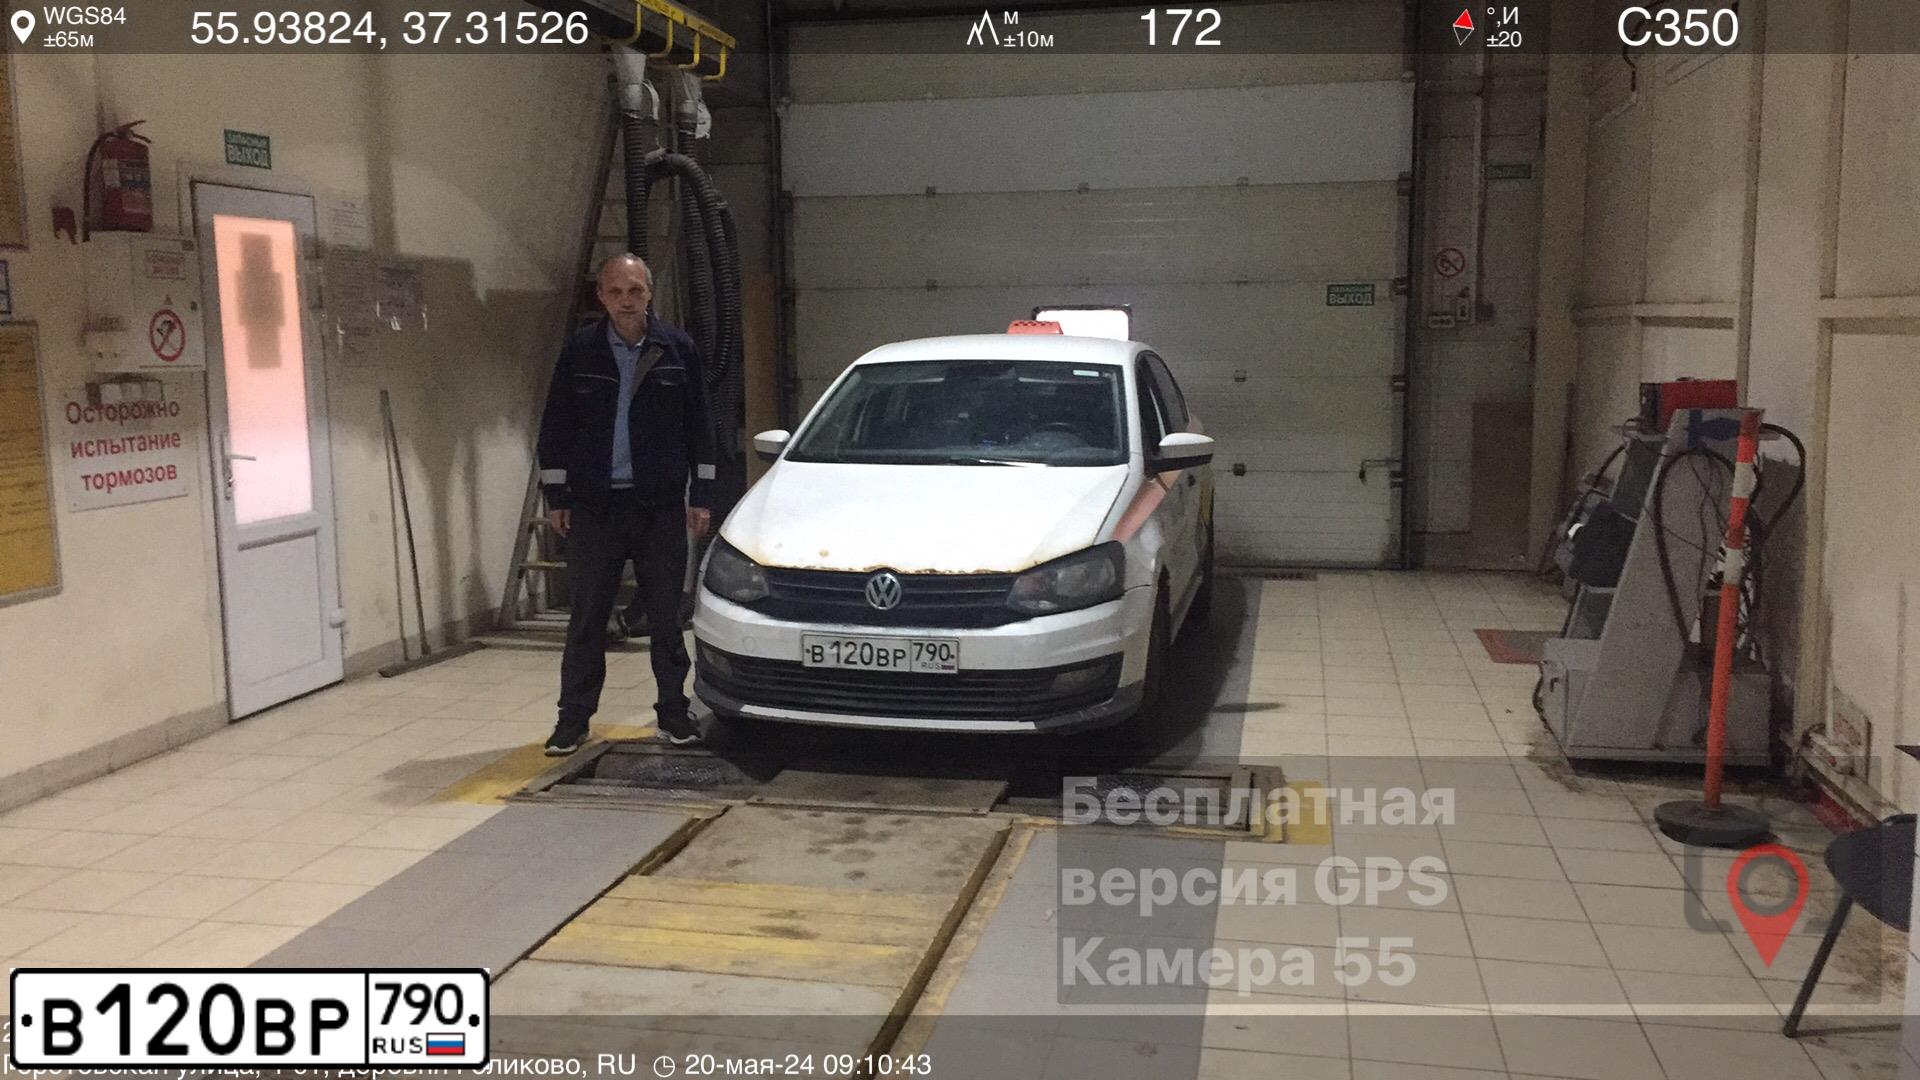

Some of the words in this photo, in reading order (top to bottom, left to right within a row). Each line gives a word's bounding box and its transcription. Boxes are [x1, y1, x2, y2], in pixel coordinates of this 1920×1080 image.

[227, 143, 270, 167] ВЫХОД
[1329, 293, 1373, 305] ВЫХОД
[65, 400, 180, 426] Осторожно
[71, 432, 181, 459] испытание
[81, 464, 177, 494] тормозов
[913, 642, 950, 661] 790
[921, 661, 942, 670] RUS
